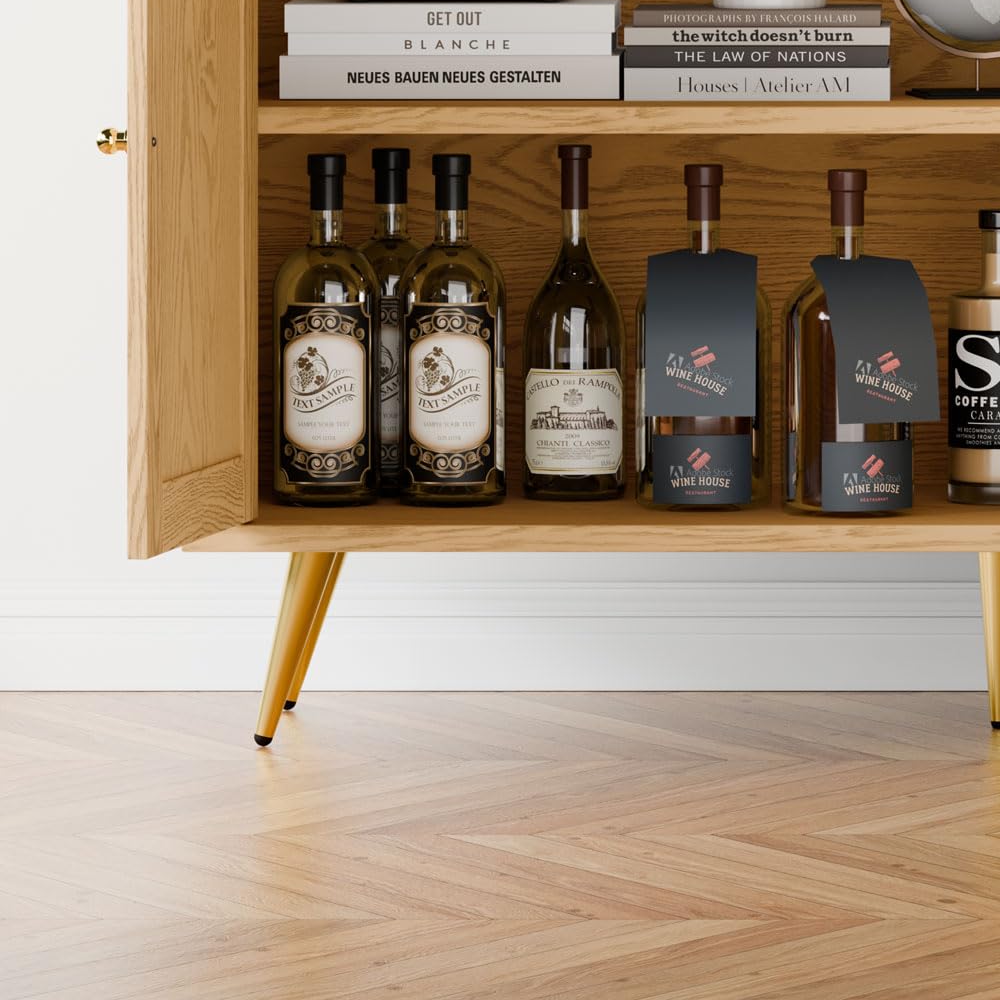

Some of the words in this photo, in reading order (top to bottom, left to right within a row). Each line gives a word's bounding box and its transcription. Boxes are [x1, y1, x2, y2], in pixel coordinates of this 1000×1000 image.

[426, 11, 452, 26] GET
[456, 11, 482, 26] OUT
[663, 13, 742, 24] PHOTOGRAPHS
[745, 13, 758, 24] BY
[760, 13, 812, 25] FRANÇOIS
[814, 13, 857, 24] HALARD
[672, 29, 700, 42] the
[701, 29, 748, 42] witch
[814, 29, 854, 42] burn
[404, 39, 511, 50] BLANCHE
[674, 51, 706, 63] THE
[712, 51, 745, 63] LAW
[750, 51, 771, 63] OF
[777, 51, 847, 63] NATIONS
[347, 71, 390, 84] NEUES
[394, 71, 439, 84] BAUEN
[442, 71, 485, 84] NEUES
[489, 70, 561, 84] GESTALTEN
[677, 76, 738, 94] Houses
[753, 76, 814, 94] Atelier
[815, 76, 850, 94] AM
[665, 366, 694, 381] WINE
[693, 374, 728, 396] HOUSE
[855, 373, 881, 387] WINE
[881, 380, 913, 401] HOUSE
[293, 397, 315, 409] TEXT
[315, 383, 355, 405] SAMPLE
[418, 397, 440, 409] TEXT
[441, 383, 481, 406] SAMPLE
[955, 396, 998, 408] COFFE
[671, 476, 696, 488] WINE
[698, 476, 731, 488] HOUSE
[844, 483, 871, 496] WINE
[873, 483, 901, 494] HOUSE
